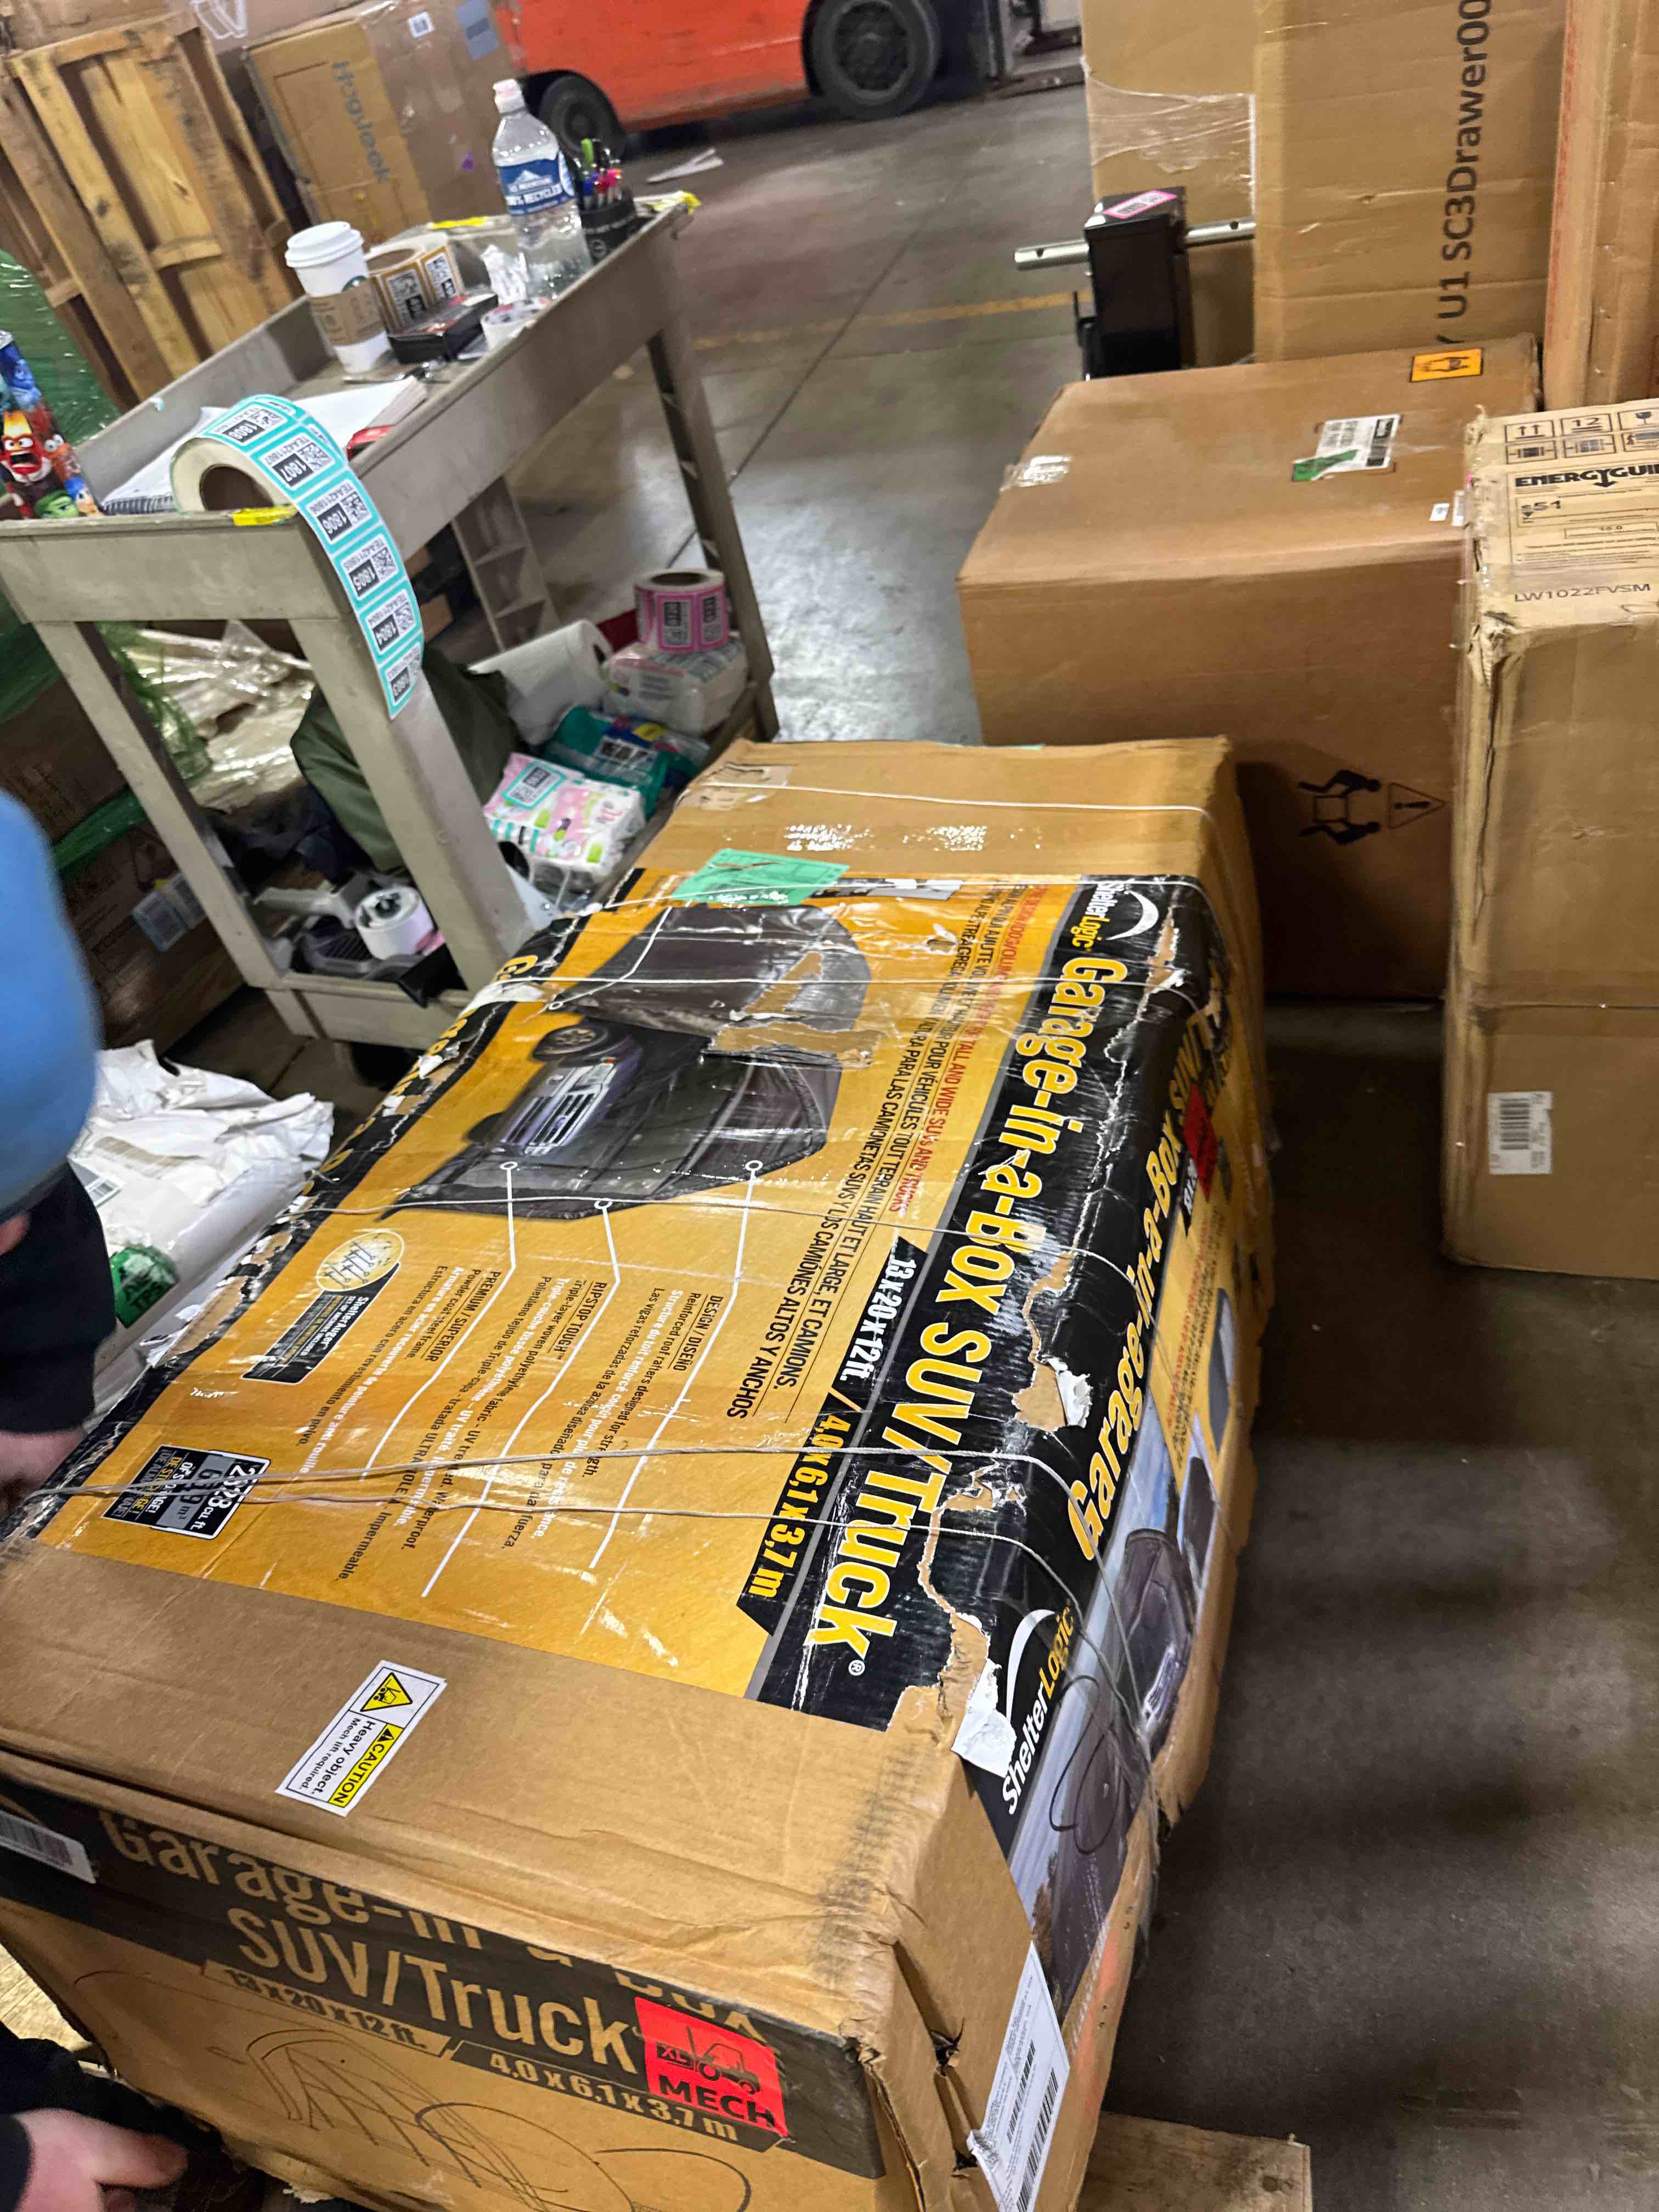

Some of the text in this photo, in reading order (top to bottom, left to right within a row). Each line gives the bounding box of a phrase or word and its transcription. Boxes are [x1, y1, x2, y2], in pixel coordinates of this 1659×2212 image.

[1574, 417, 1600, 428] 12
[281, 459, 307, 481] 1807
[1515, 464, 1659, 488] ENERGYGUI
[326, 510, 348, 535] 1806
[353, 567, 376, 590] 1805
[894, 1049, 921, 1076] PARA
[952, 1040, 976, 1061] TALL
[944, 1063, 966, 1084] AND
[885, 1079, 909, 1099] LAS
[928, 1087, 957, 1116] WIDE
[853, 1102, 899, 1170] CAMIONETAS
[938, 957, 1127, 1312] Garage-in-a-Box
[909, 1147, 933, 1169] AND
[837, 1172, 866, 1199] SUVS
[888, 1172, 923, 1212] TRUCKS
[772, 1041, 949, 1390] POUR VÉHICULES TOUT TERRAIN HAUT ET LARGE, ET CAMIONS.
[786, 1231, 833, 1296] CAMIÓNES
[884, 1257, 916, 1278] 13
[411, 1265, 448, 1304] Estructura
[454, 1269, 481, 1297] Powder
[463, 1271, 501, 1311] PREMIUM
[648, 1288, 665, 1302] Las
[877, 1279, 904, 1292] x
[439, 1298, 458, 1314] coat
[575, 1282, 607, 1320] RIPSTOP
[635, 1304, 654, 1324] vigas
[651, 1290, 683, 1328] Structure
[668, 1293, 701, 1336] Reinforced
[695, 1295, 723, 1329] DESIGN
[867, 1292, 902, 1318] 20
[764, 1296, 800, 1342] ALTOS
[859, 1319, 887, 1334] x
[372, 1339, 389, 1353] con
[404, 1335, 432, 1359] frame.
[424, 1318, 467, 1362] SUPERIOR
[493, 1340, 507, 1350] de
[658, 1337, 675, 1355] roof
[673, 1336, 702, 1371] DISEÑO
[601, 1370, 616, 1380] de
[640, 1356, 664, 1384] rafters
[726, 1356, 772, 1419] ANCHOS
[430, 1398, 461, 1430] tratada
[455, 1410, 472, 1422] UV
[476, 1398, 503, 1421] fabric
[617, 1385, 648, 1420] designed
[464, 1430, 481, 1444] UV
[608, 1421, 625, 1434] for
[566, 1439, 588, 1458] plu
[786, 1466, 828, 1501] 6,1
[334, 1512, 391, 1581] Impermeable.
[763, 1523, 805, 1568] 3,7
[748, 1568, 783, 1598] m
[1001, 1605, 1076, 1815] ShelterLogic
[299, 1717, 360, 1790] Mech lift required.
[311, 1720, 376, 1795] Heavy object.
[334, 1743, 385, 1804] CAUTION
[283, 1986, 326, 2015] 20
[330, 2007, 348, 2023] x
[349, 2010, 388, 2036] 12
[545, 2070, 566, 2091] x
[621, 2092, 644, 2113] x
[702, 2118, 738, 2142] m
[662, 2047, 687, 2063] XL
[658, 2073, 776, 2128] MECH
